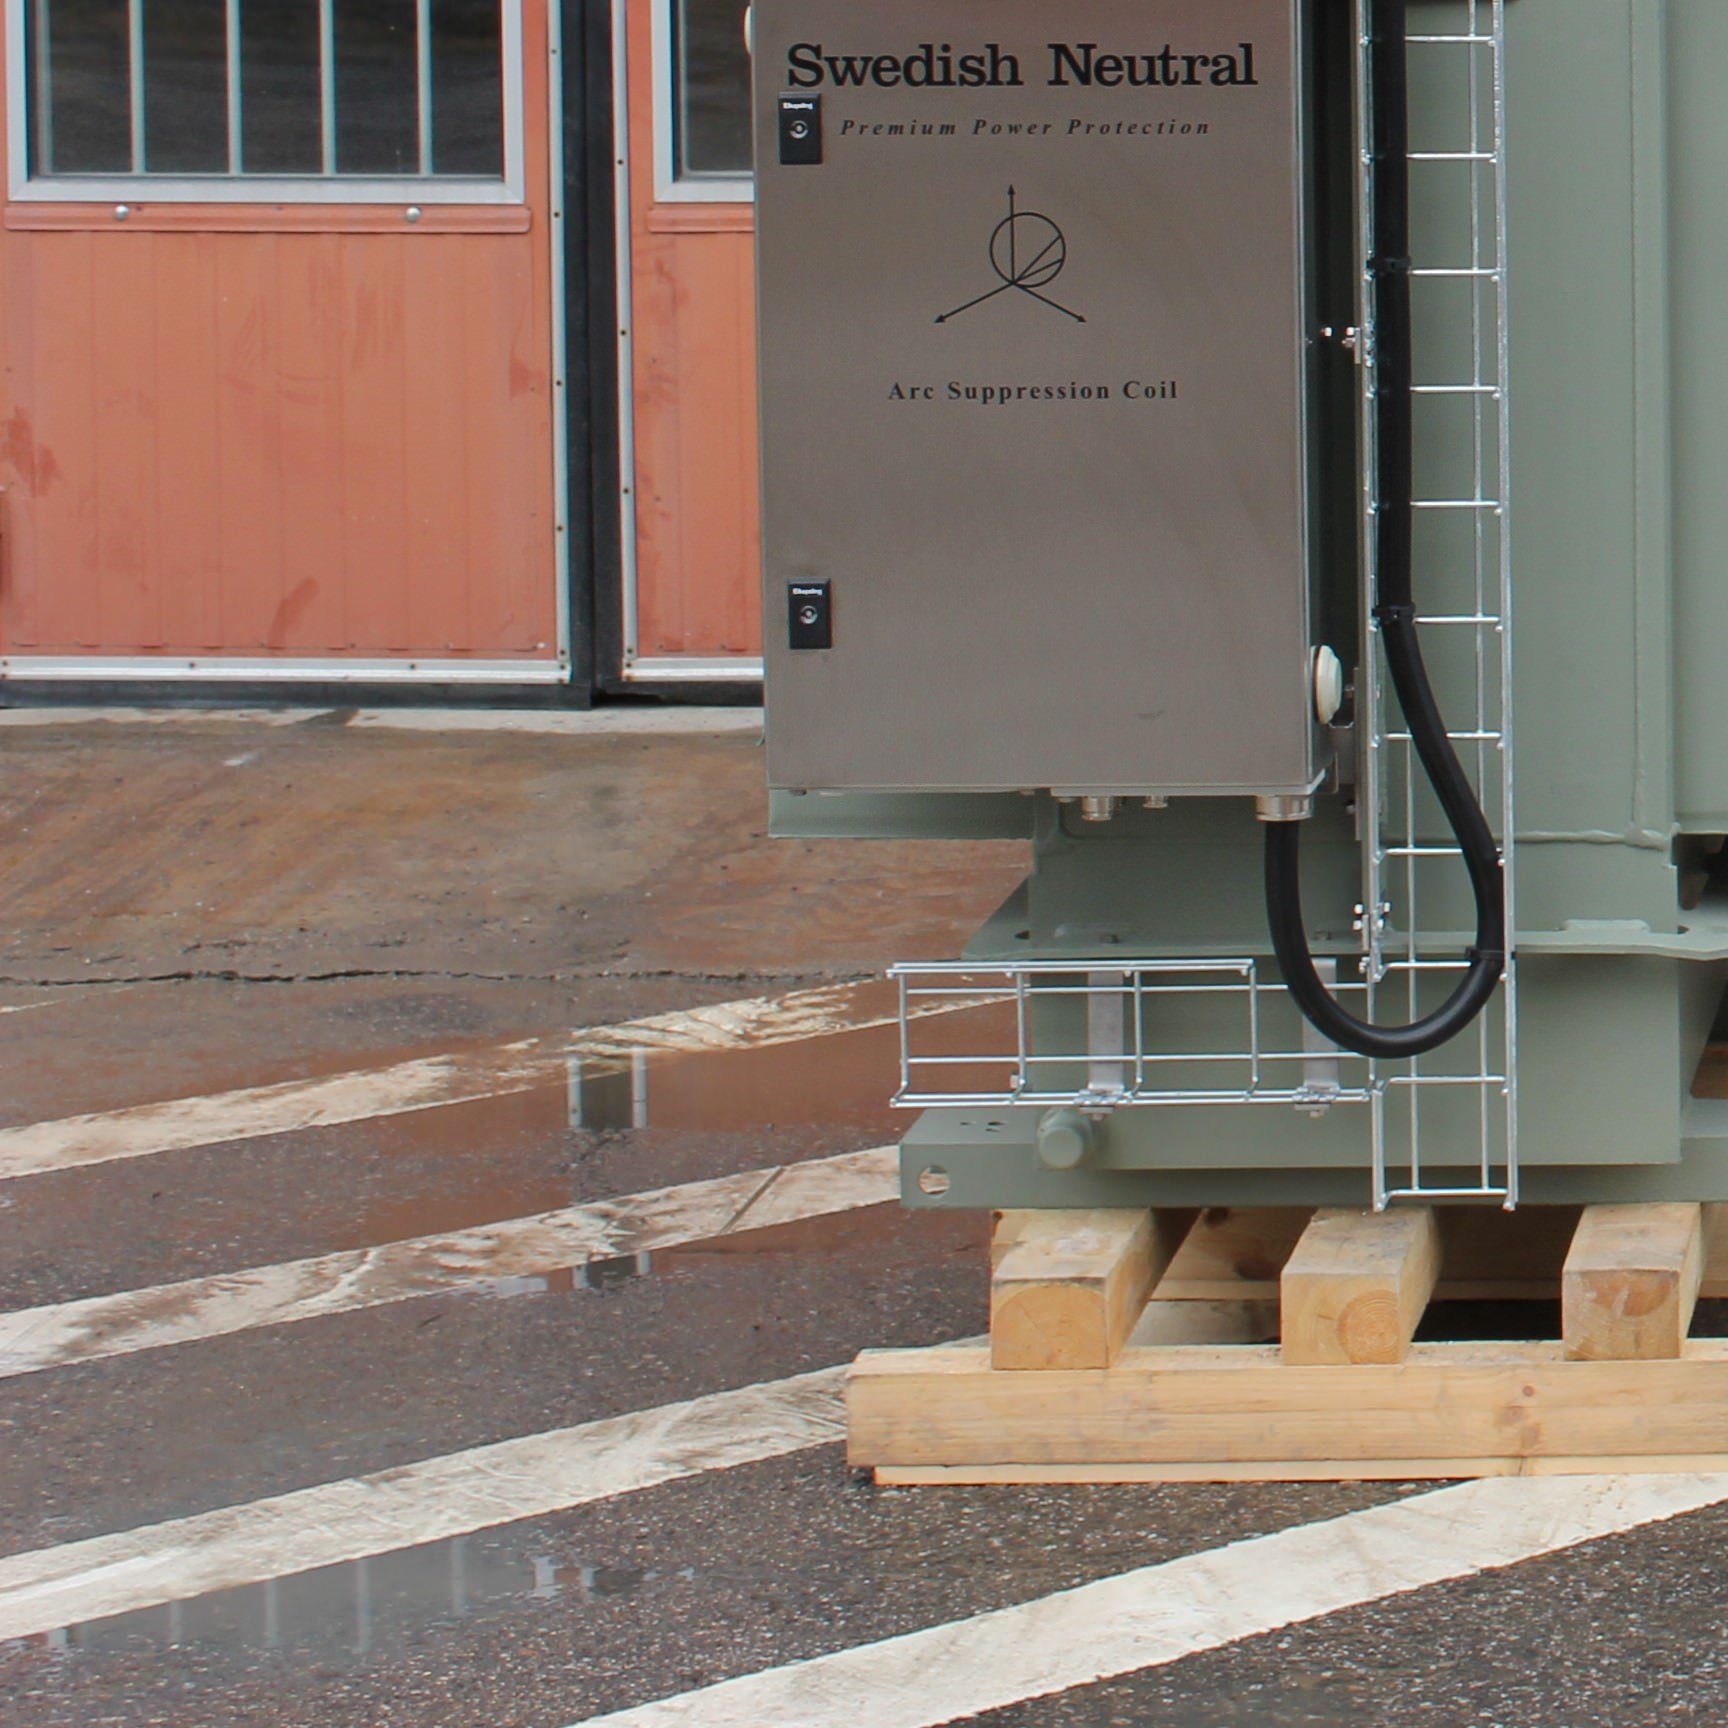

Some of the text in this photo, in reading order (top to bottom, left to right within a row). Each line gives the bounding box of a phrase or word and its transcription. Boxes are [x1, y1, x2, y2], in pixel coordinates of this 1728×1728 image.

[787, 42, 1258, 88] Swedish Neutral
[839, 118, 1211, 136] Premium Power Protection
[888, 380, 1178, 405] Arc Suppression Coil
